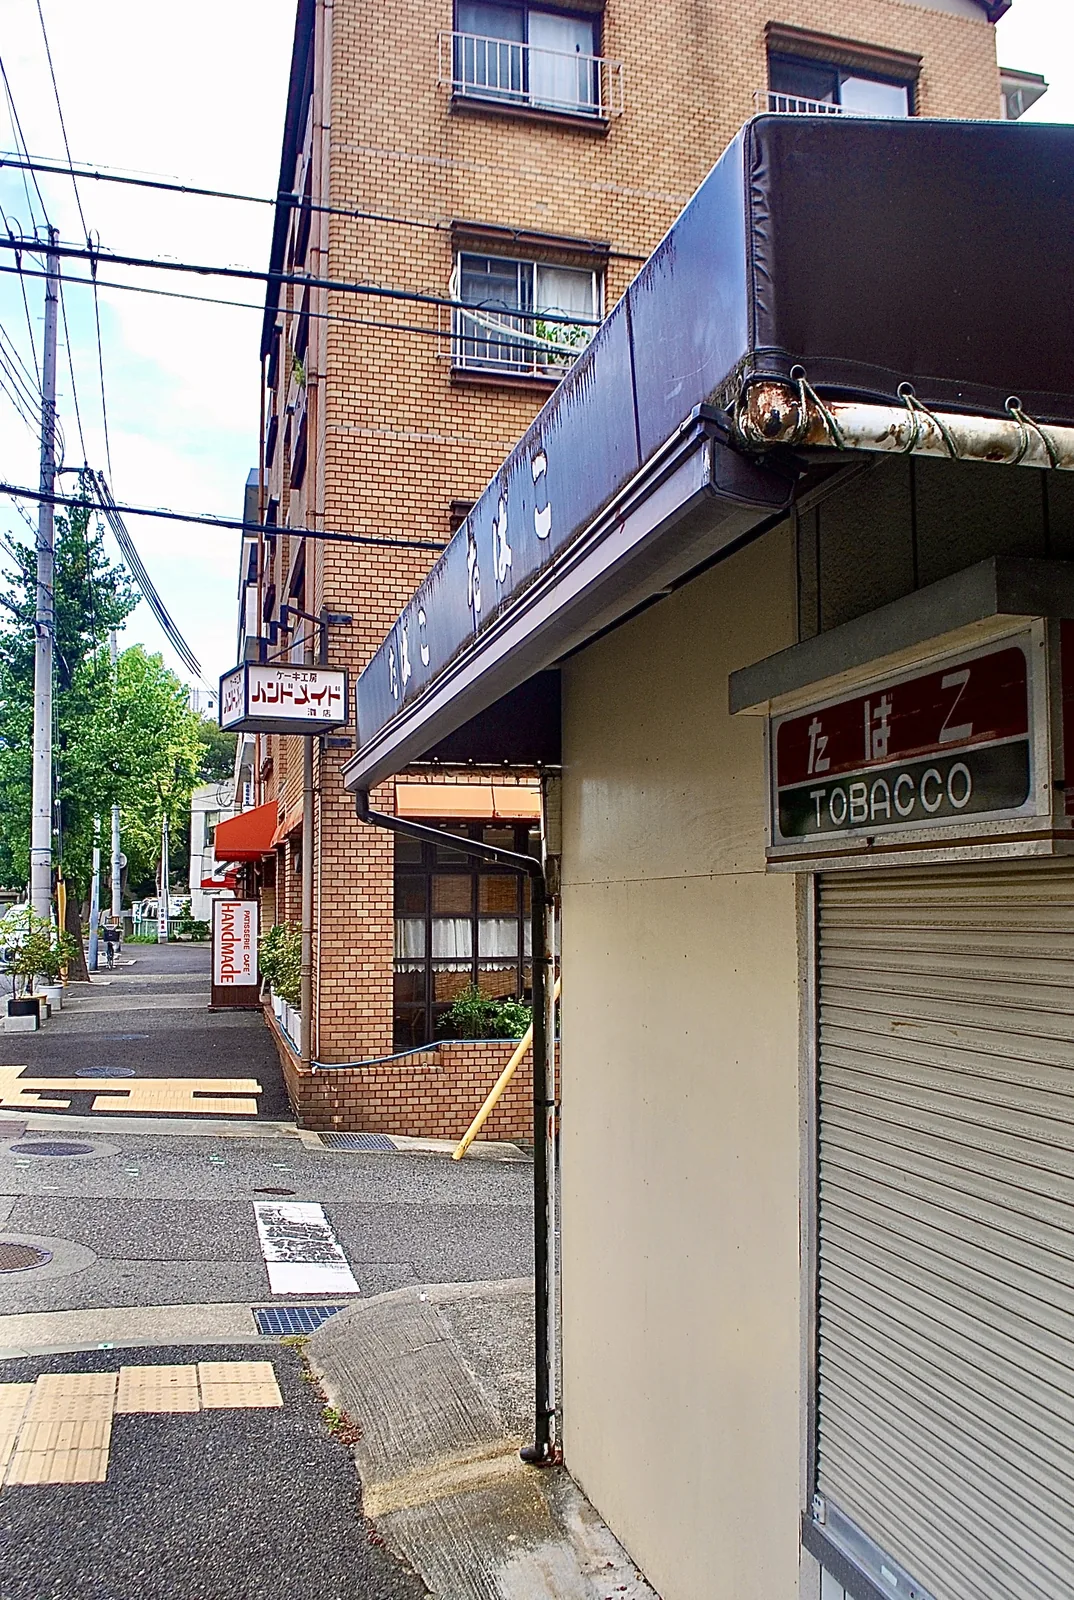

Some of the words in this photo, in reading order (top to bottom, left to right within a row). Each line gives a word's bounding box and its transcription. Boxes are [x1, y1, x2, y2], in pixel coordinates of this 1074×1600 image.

[251, 681, 341, 706] ハンドメイド
[276, 670, 318, 683] ケーキ工房
[807, 668, 973, 774] たばこ
[810, 762, 972, 828] TOBACCO
